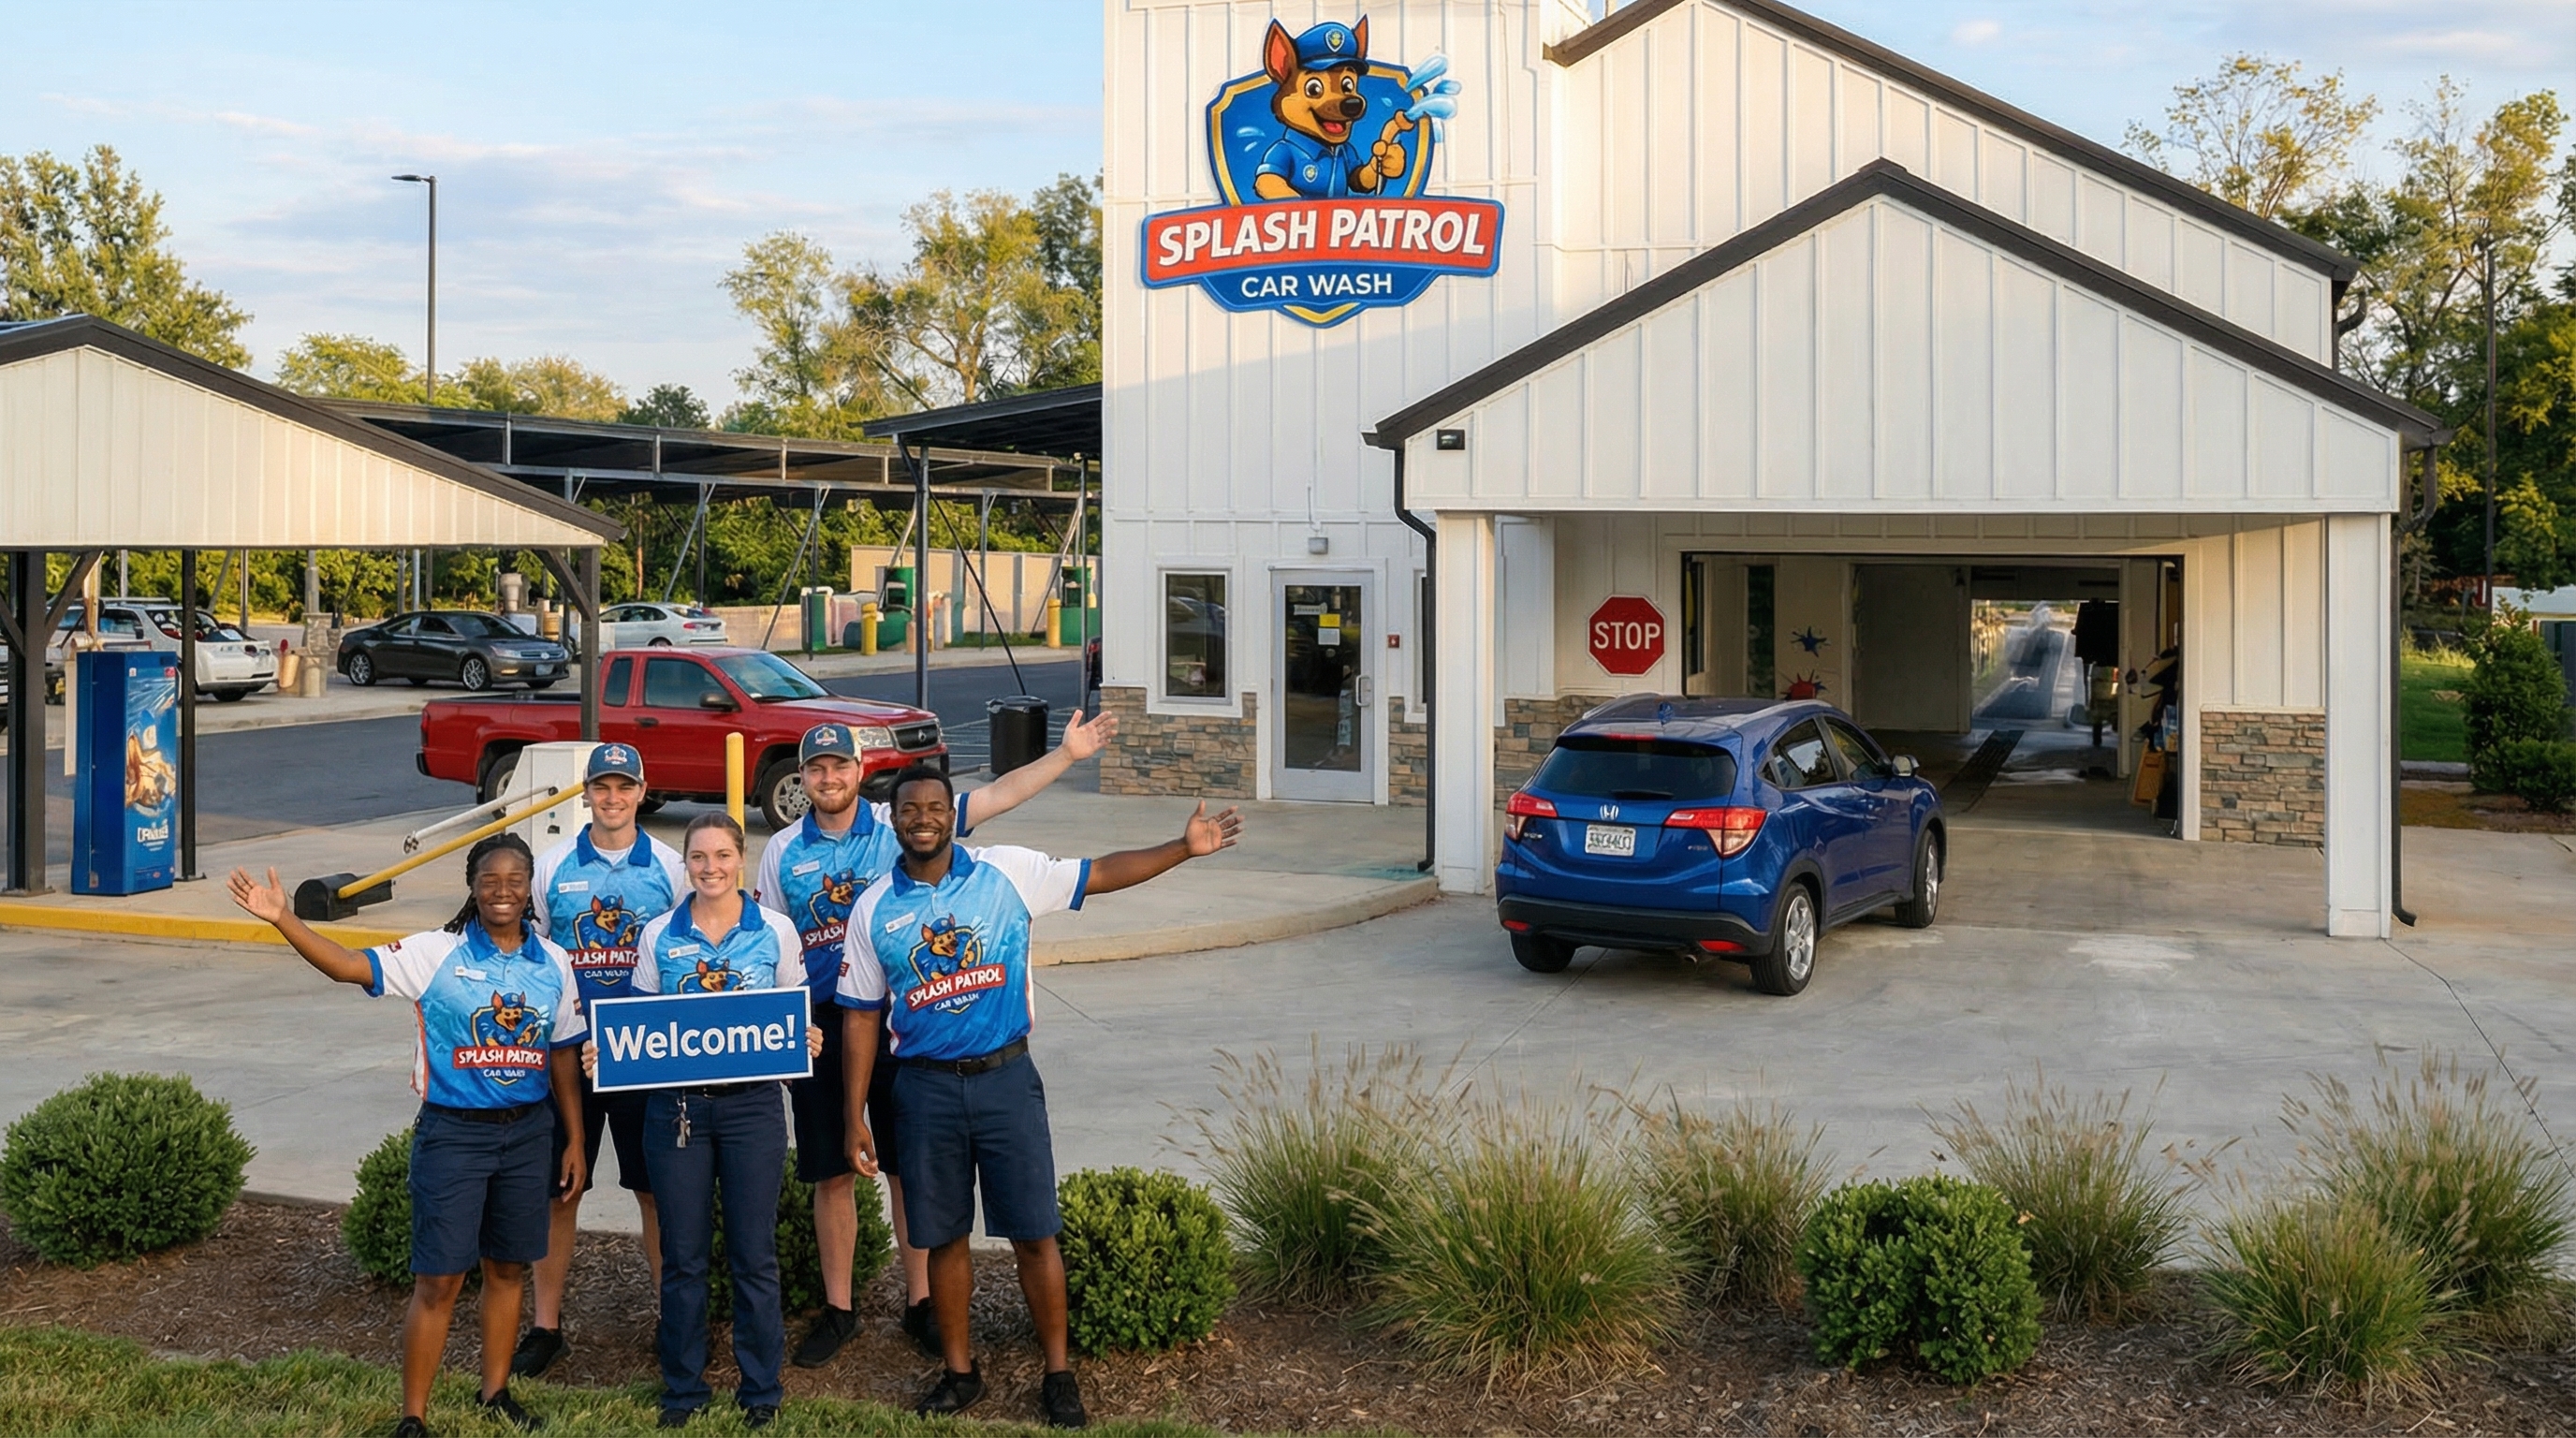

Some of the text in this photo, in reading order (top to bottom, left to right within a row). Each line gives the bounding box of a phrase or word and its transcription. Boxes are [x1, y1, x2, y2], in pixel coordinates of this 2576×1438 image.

[1159, 208, 1486, 266] SPLASH PATROL
[1241, 272, 1392, 298] CAR WASH
[1593, 621, 1661, 650] STOP
[911, 967, 1002, 1006] SPLASH PATROL
[934, 1000, 951, 1011] CAR
[604, 1014, 796, 1063] Welcome!
[459, 1049, 504, 1064] SPLASH
